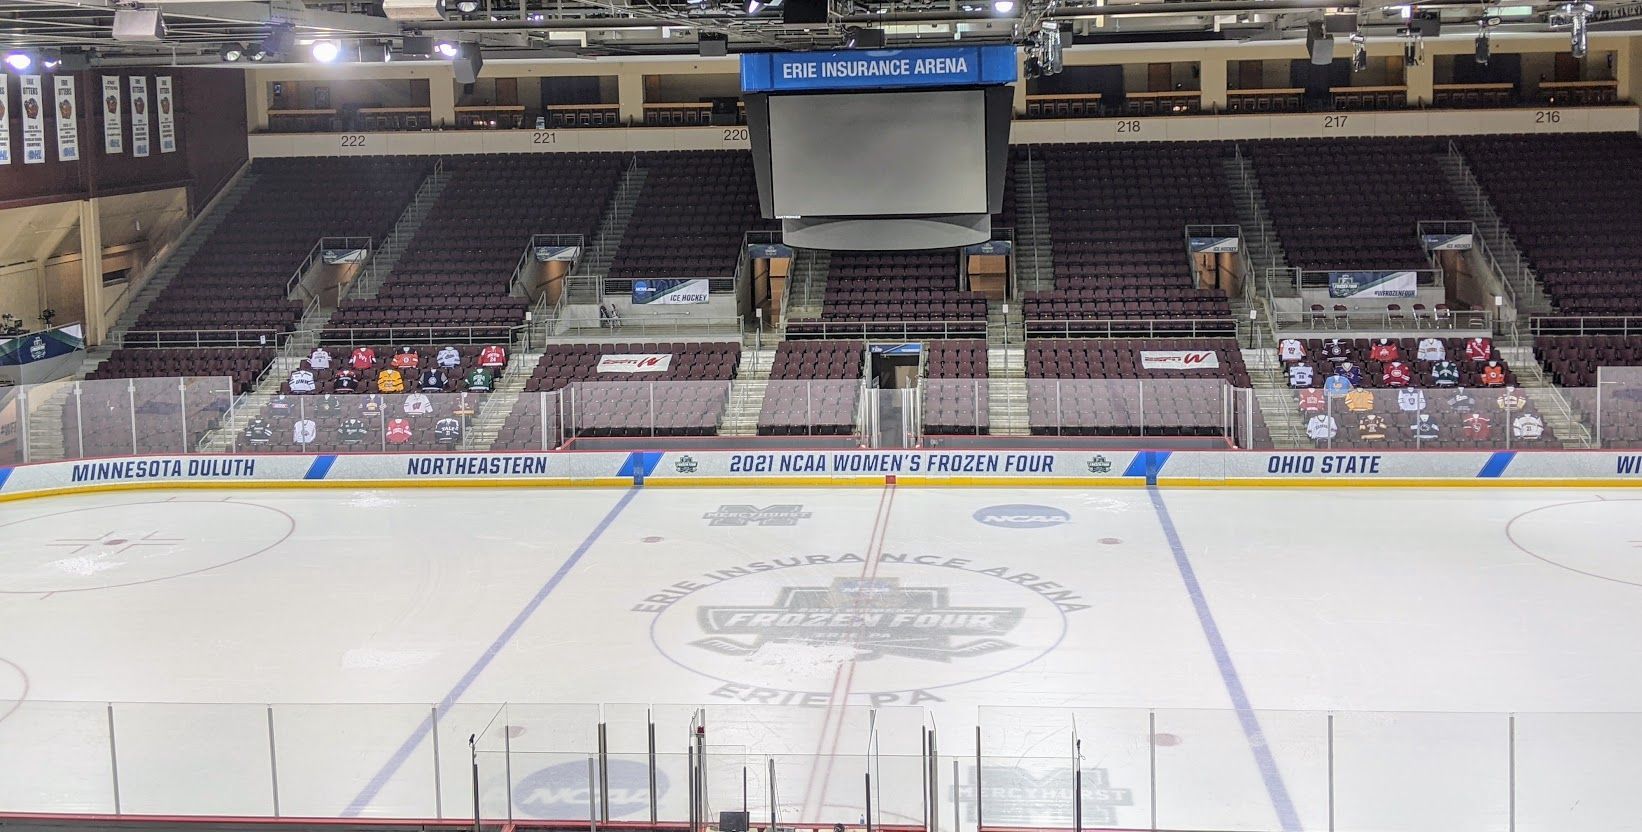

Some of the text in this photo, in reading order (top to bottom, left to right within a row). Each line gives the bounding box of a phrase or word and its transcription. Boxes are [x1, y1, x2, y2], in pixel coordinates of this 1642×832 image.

[783, 59, 968, 84] ERIE INSURANCE ARENA
[1323, 116, 1348, 128] 217
[1535, 112, 1561, 124] 216
[723, 129, 748, 141] 220
[1116, 121, 1141, 133] 218
[341, 135, 366, 147] 222
[533, 132, 557, 144] 221
[682, 294, 708, 302] HOCKEY
[72, 458, 254, 482] MINNESOTA DULUTH
[407, 456, 547, 475] NORTHEASTERN
[730, 454, 1054, 473] 2021 NCAA WOMEN'S FROZEN FOUR
[1267, 456, 1381, 474] OHIO STATE
[630, 553, 1092, 614] ERIE INSURANCE ARENA
[724, 613, 997, 628] FROZEN FOUR
[709, 683, 946, 708] ERIE PA
[521, 787, 662, 806] NCAA
